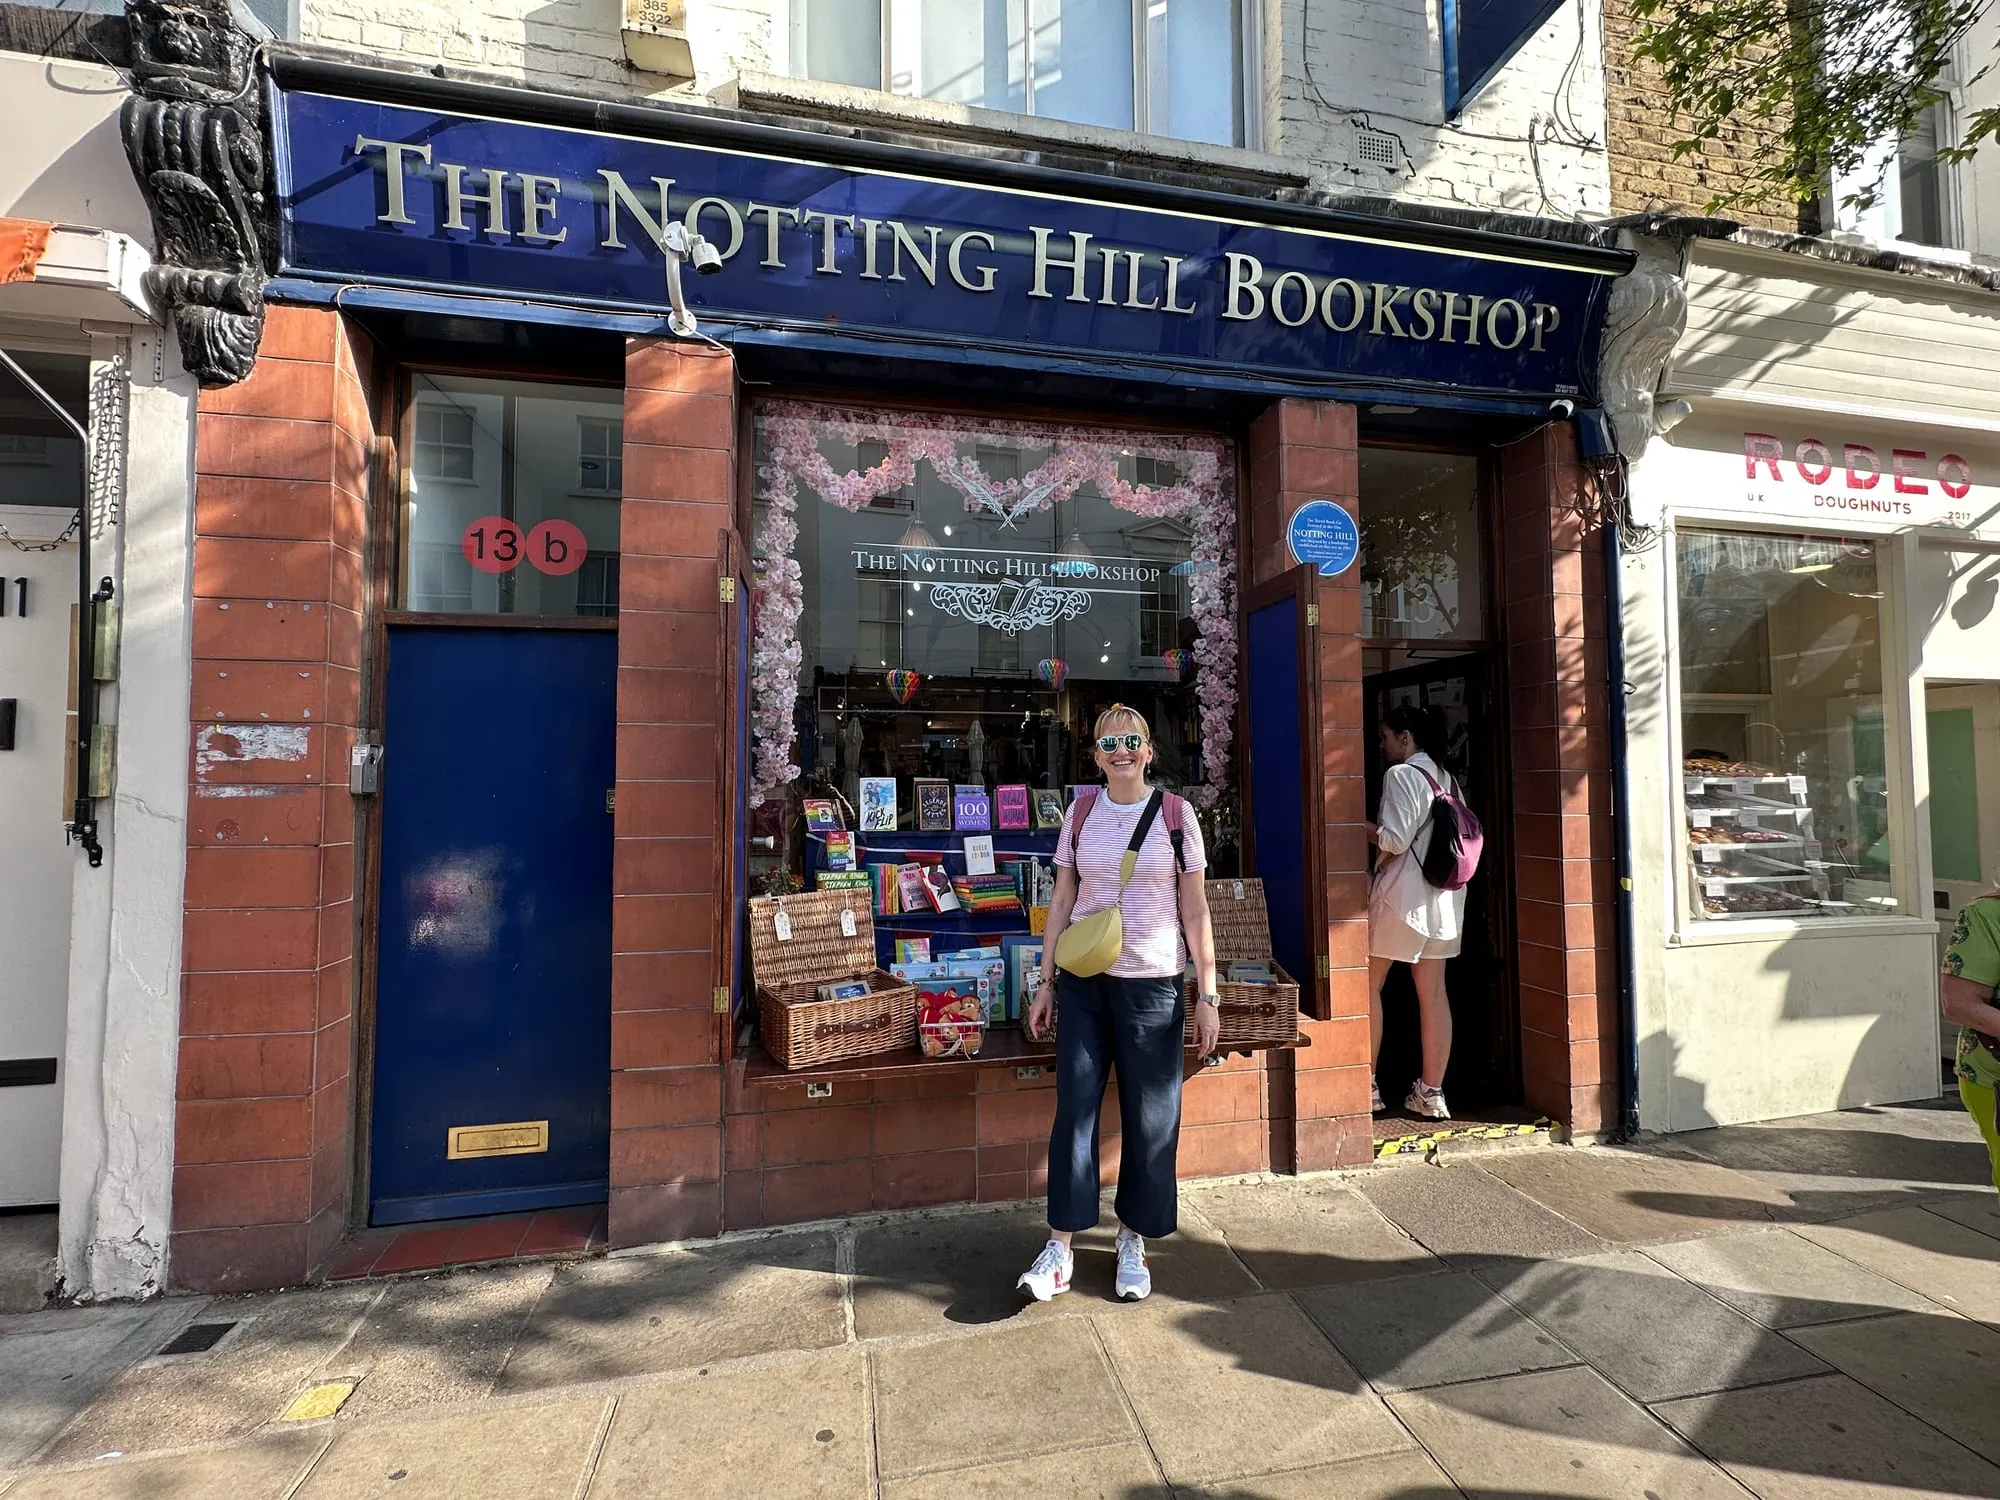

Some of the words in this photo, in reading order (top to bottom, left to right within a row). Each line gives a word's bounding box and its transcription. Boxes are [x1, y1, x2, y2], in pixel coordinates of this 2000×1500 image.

[639, 11, 672, 25] 3322
[354, 134, 567, 243] THE
[597, 168, 998, 292] NOTTING
[1027, 225, 1196, 315] HILL
[1222, 252, 1560, 353] BOOKSHOP
[1744, 432, 1972, 499] RODEO
[1814, 495, 1912, 515] DOUGHNUTS
[1948, 511, 1971, 520] 2017
[1294, 529, 1333, 539] NOTTING
[1335, 532, 1354, 540] HILL
[470, 528, 518, 561] 13
[545, 531, 568, 563] b
[851, 550, 897, 571] THE
[902, 553, 999, 576] NOTTING
[1004, 558, 1052, 578] HILL
[1390, 582, 1436, 623] 13
[866, 807, 885, 823] KICK
[957, 801, 987, 816] 100
[874, 814, 894, 830] FLIP
[824, 880, 852, 889] STEPHEN
